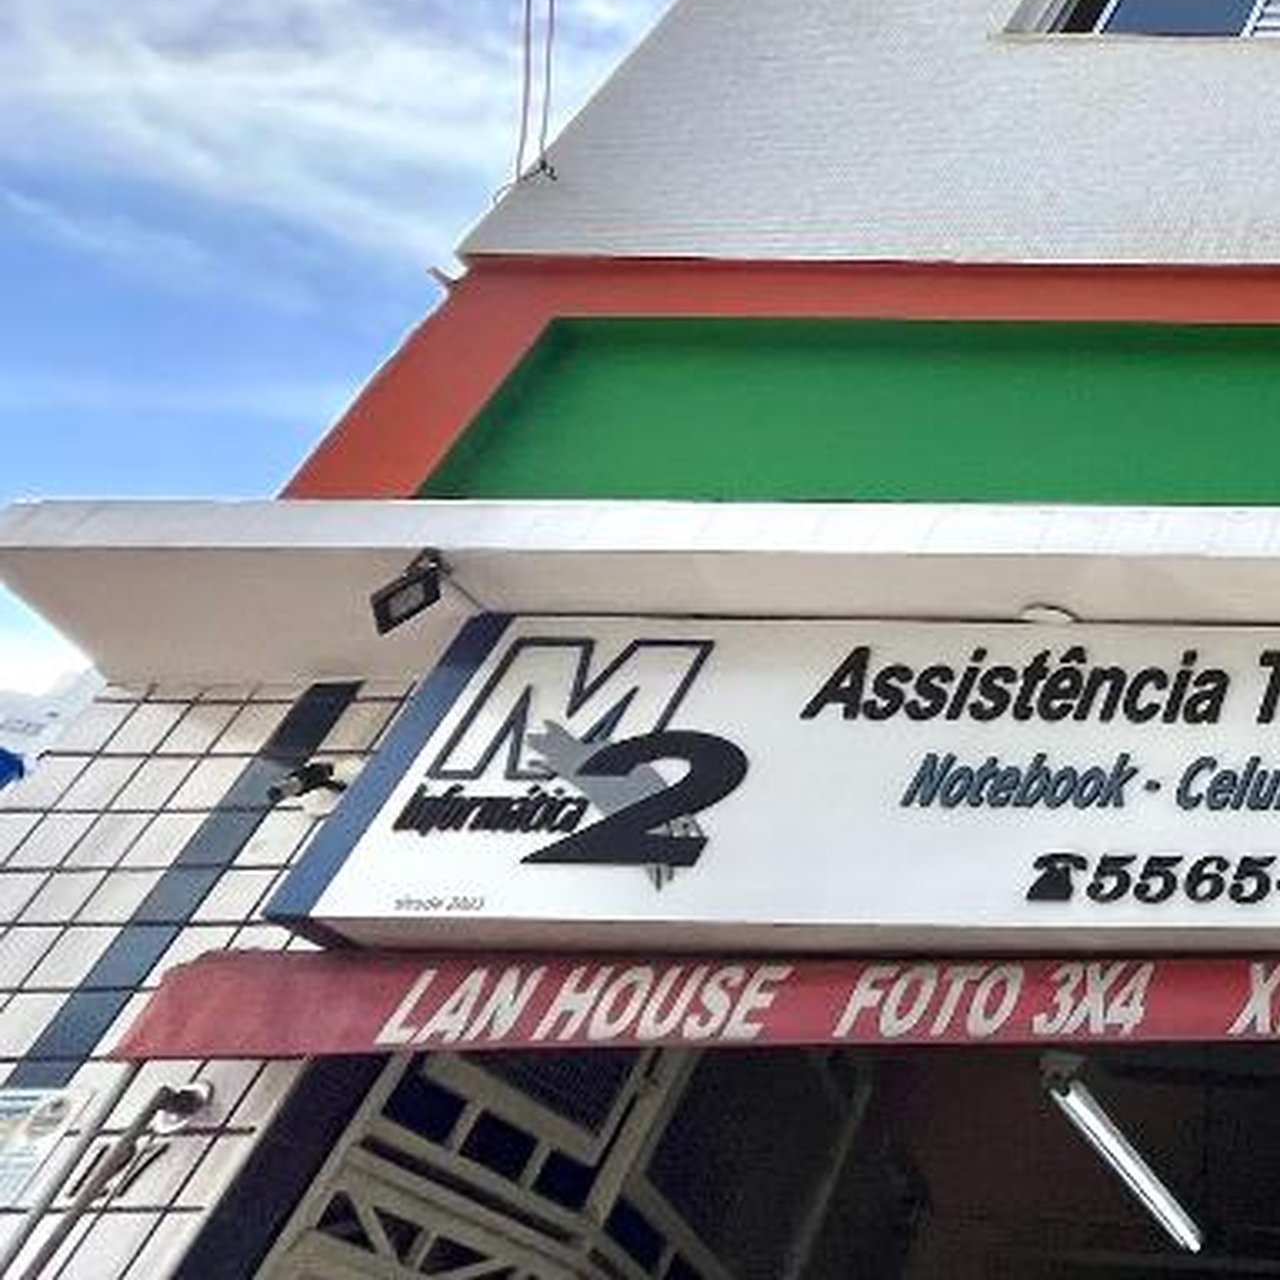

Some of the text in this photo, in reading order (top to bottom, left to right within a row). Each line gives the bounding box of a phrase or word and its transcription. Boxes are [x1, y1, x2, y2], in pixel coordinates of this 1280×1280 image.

[801, 644, 1231, 723] Assistência
[901, 751, 1139, 809] Notebook
[373, 966, 549, 1044] LAN
[530, 964, 795, 1041] HOUSE
[832, 961, 1025, 1038] FOTO
[1032, 960, 1155, 1036] 3X4
